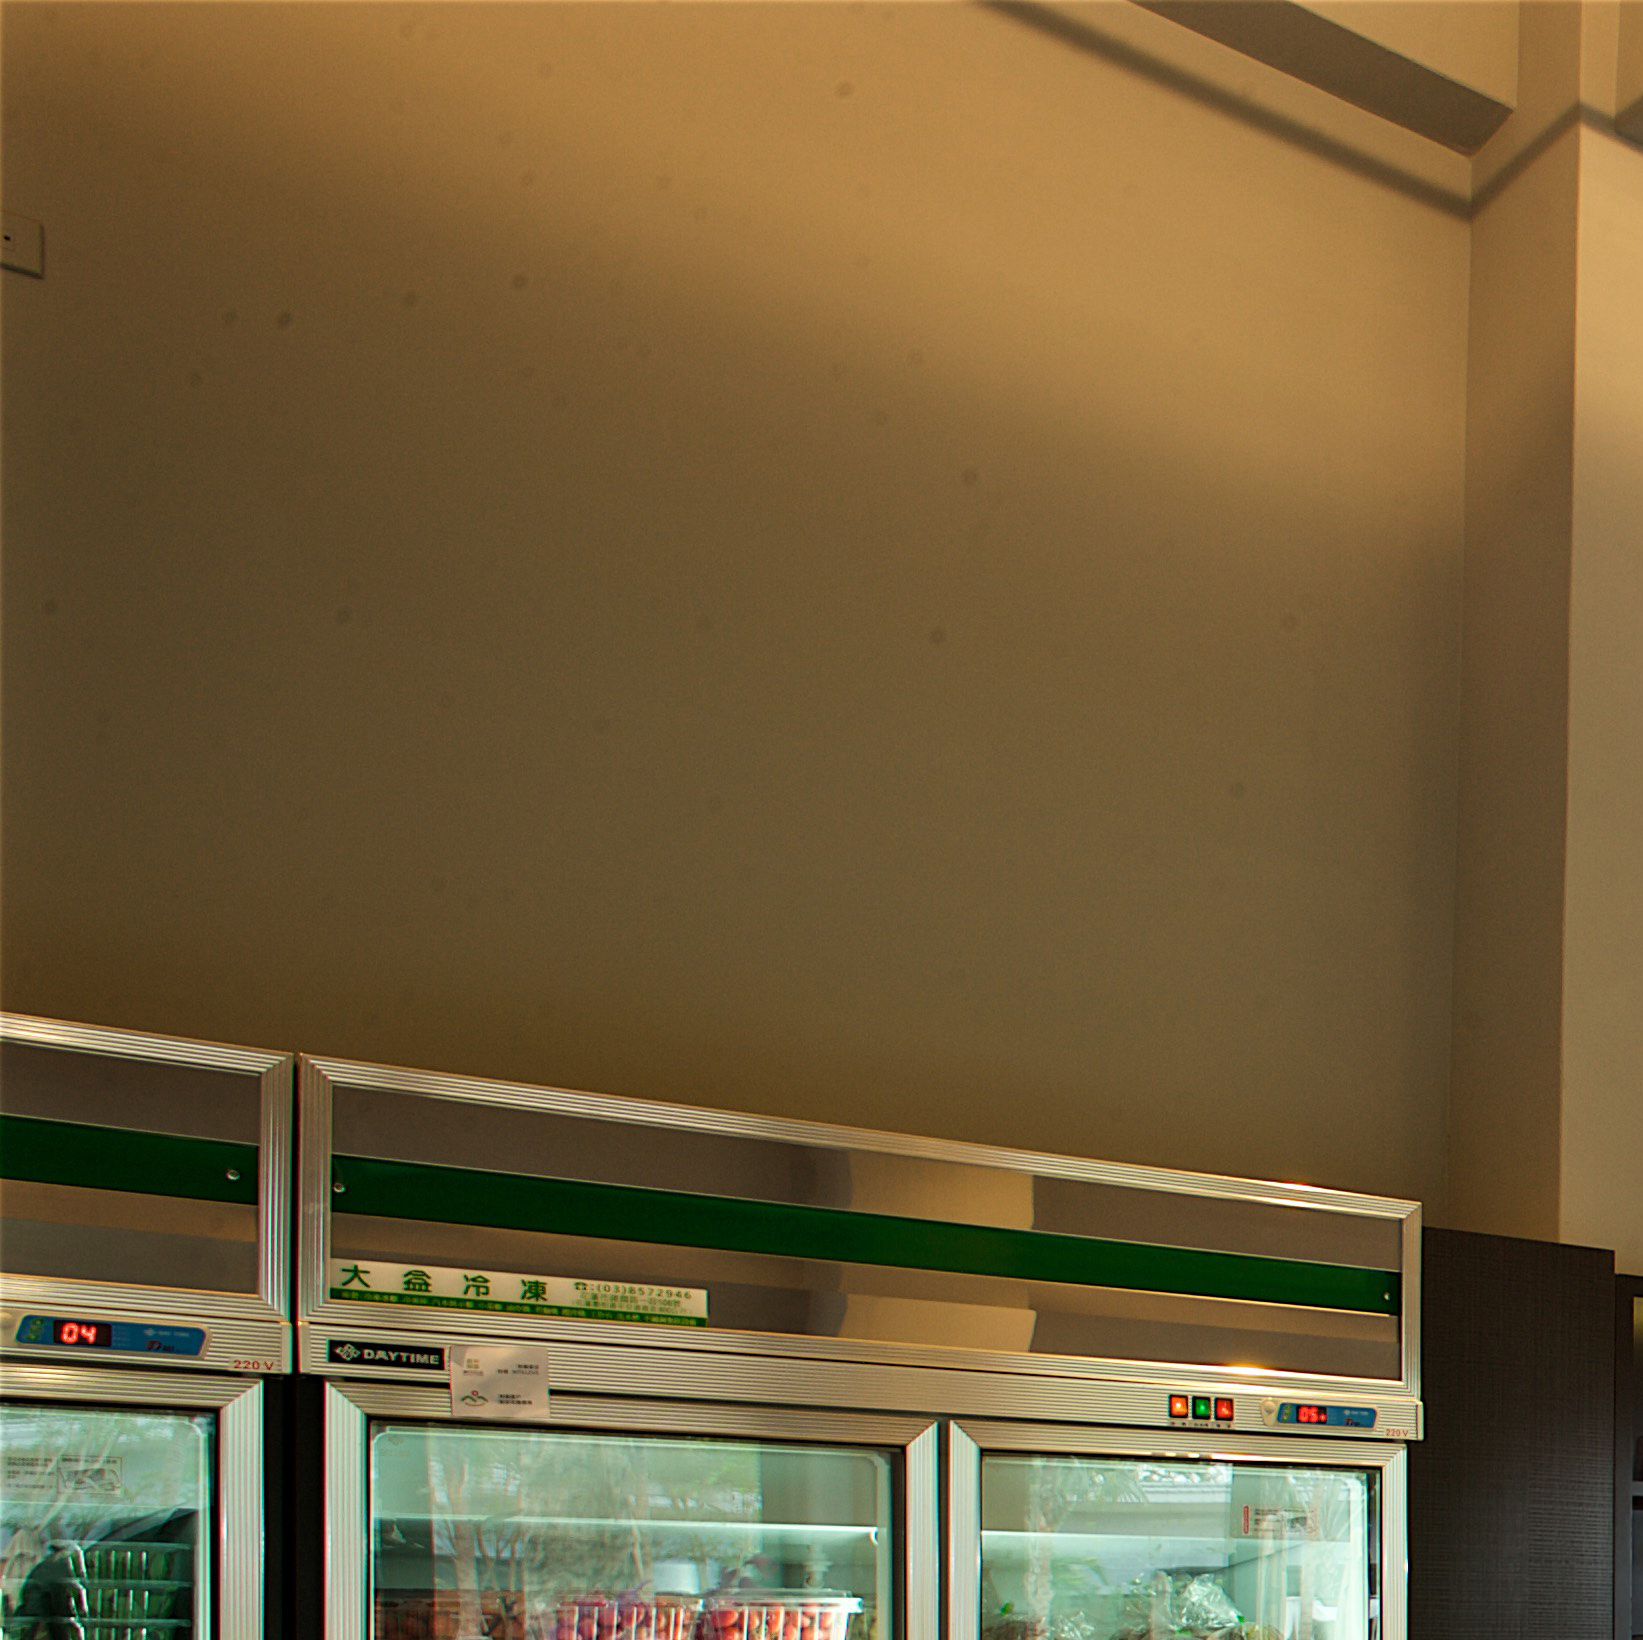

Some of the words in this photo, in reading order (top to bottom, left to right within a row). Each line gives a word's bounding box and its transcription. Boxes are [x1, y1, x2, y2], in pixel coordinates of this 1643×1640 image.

[60, 1322, 97, 1344] 04
[233, 1359, 260, 1370] 220
[264, 1360, 275, 1371] V
[363, 1347, 440, 1366] DAYTIME
